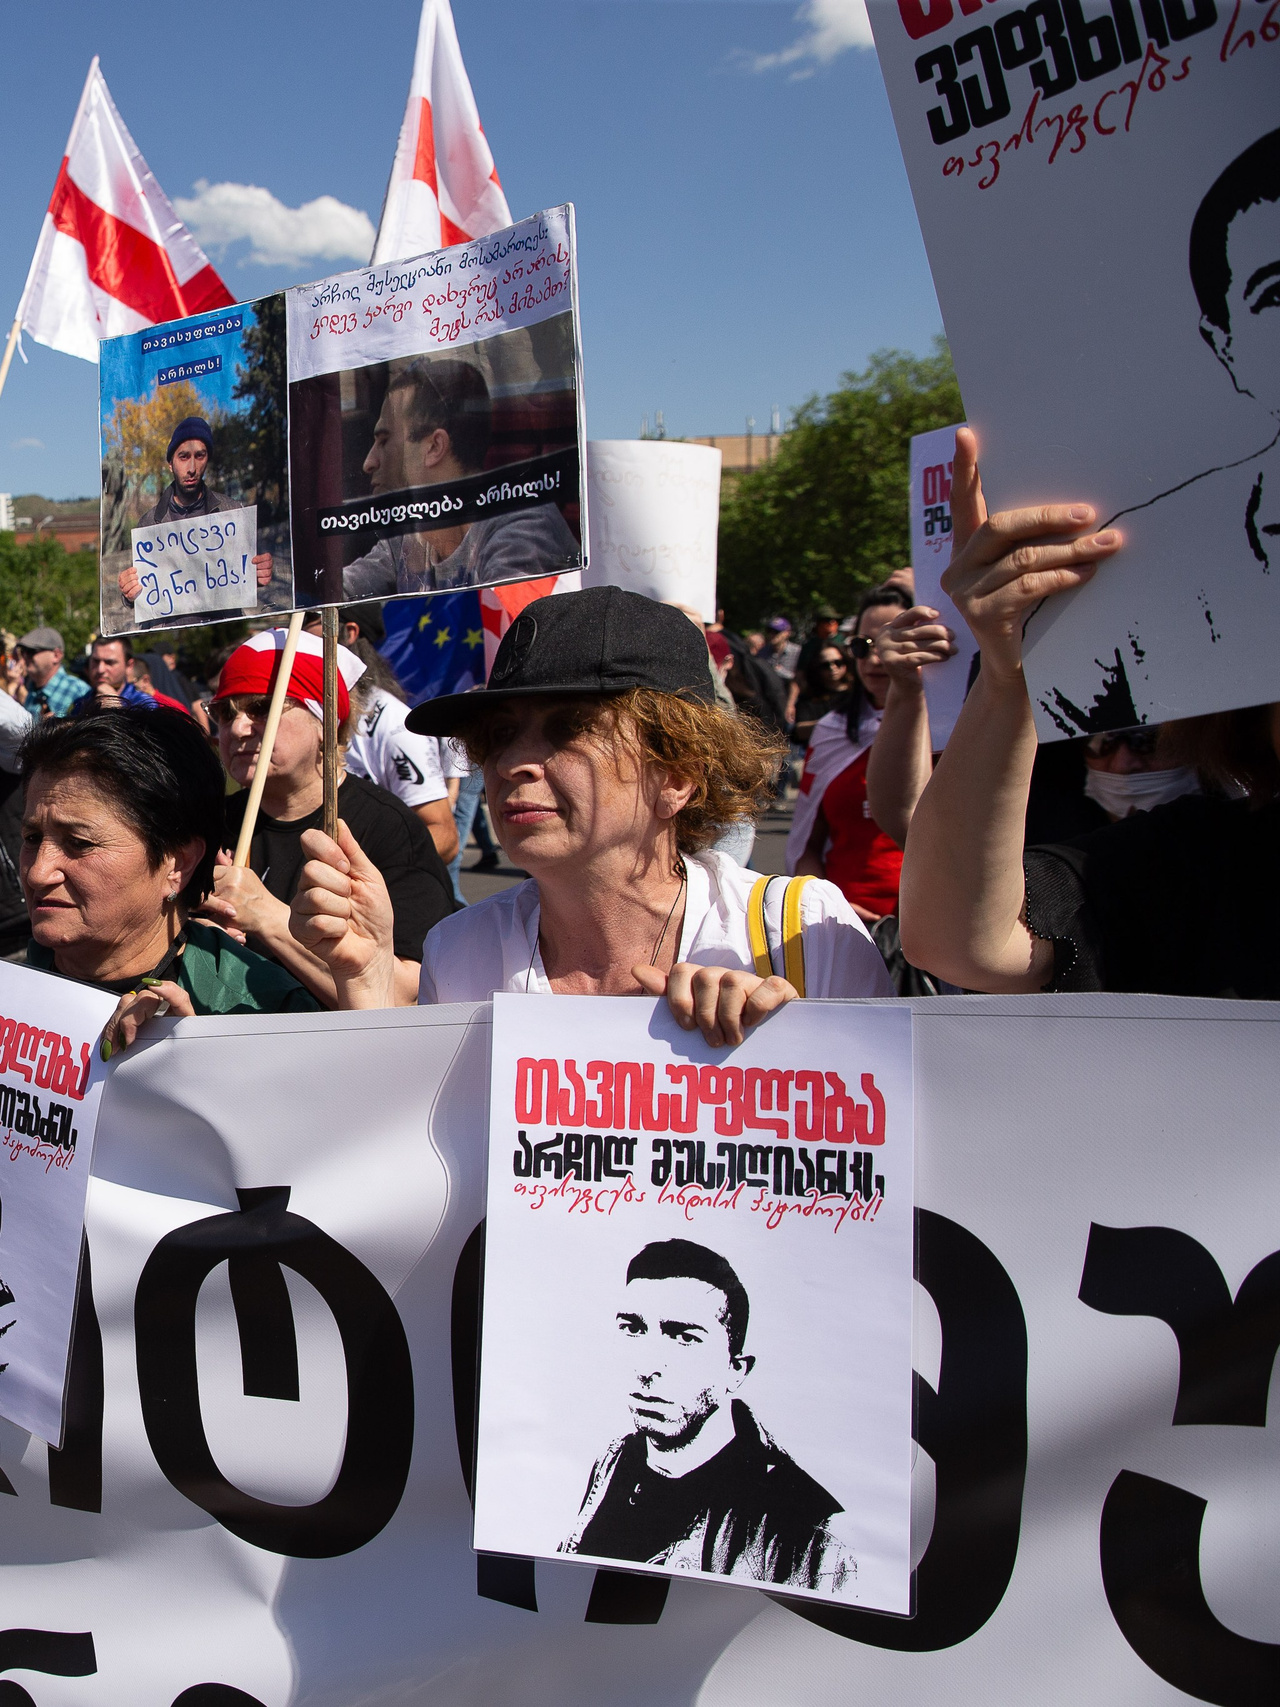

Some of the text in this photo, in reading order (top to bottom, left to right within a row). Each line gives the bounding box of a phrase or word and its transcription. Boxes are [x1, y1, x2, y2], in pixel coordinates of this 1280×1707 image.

[310, 312, 358, 340] კიდევ
[362, 295, 413, 328] კარგი
[312, 282, 361, 308] არჩილ
[474, 298, 505, 325] რას
[143, 318, 242, 351] თავისუფლება
[159, 357, 221, 382] არჩილს!
[321, 495, 464, 531] თავისუფლება
[476, 470, 561, 506] არჩილს!
[141, 554, 248, 616] შენი ხმა!
[515, 1057, 887, 1146] თავისუფლება
[513, 1130, 885, 1202] არჩილ მუსელიანცს
